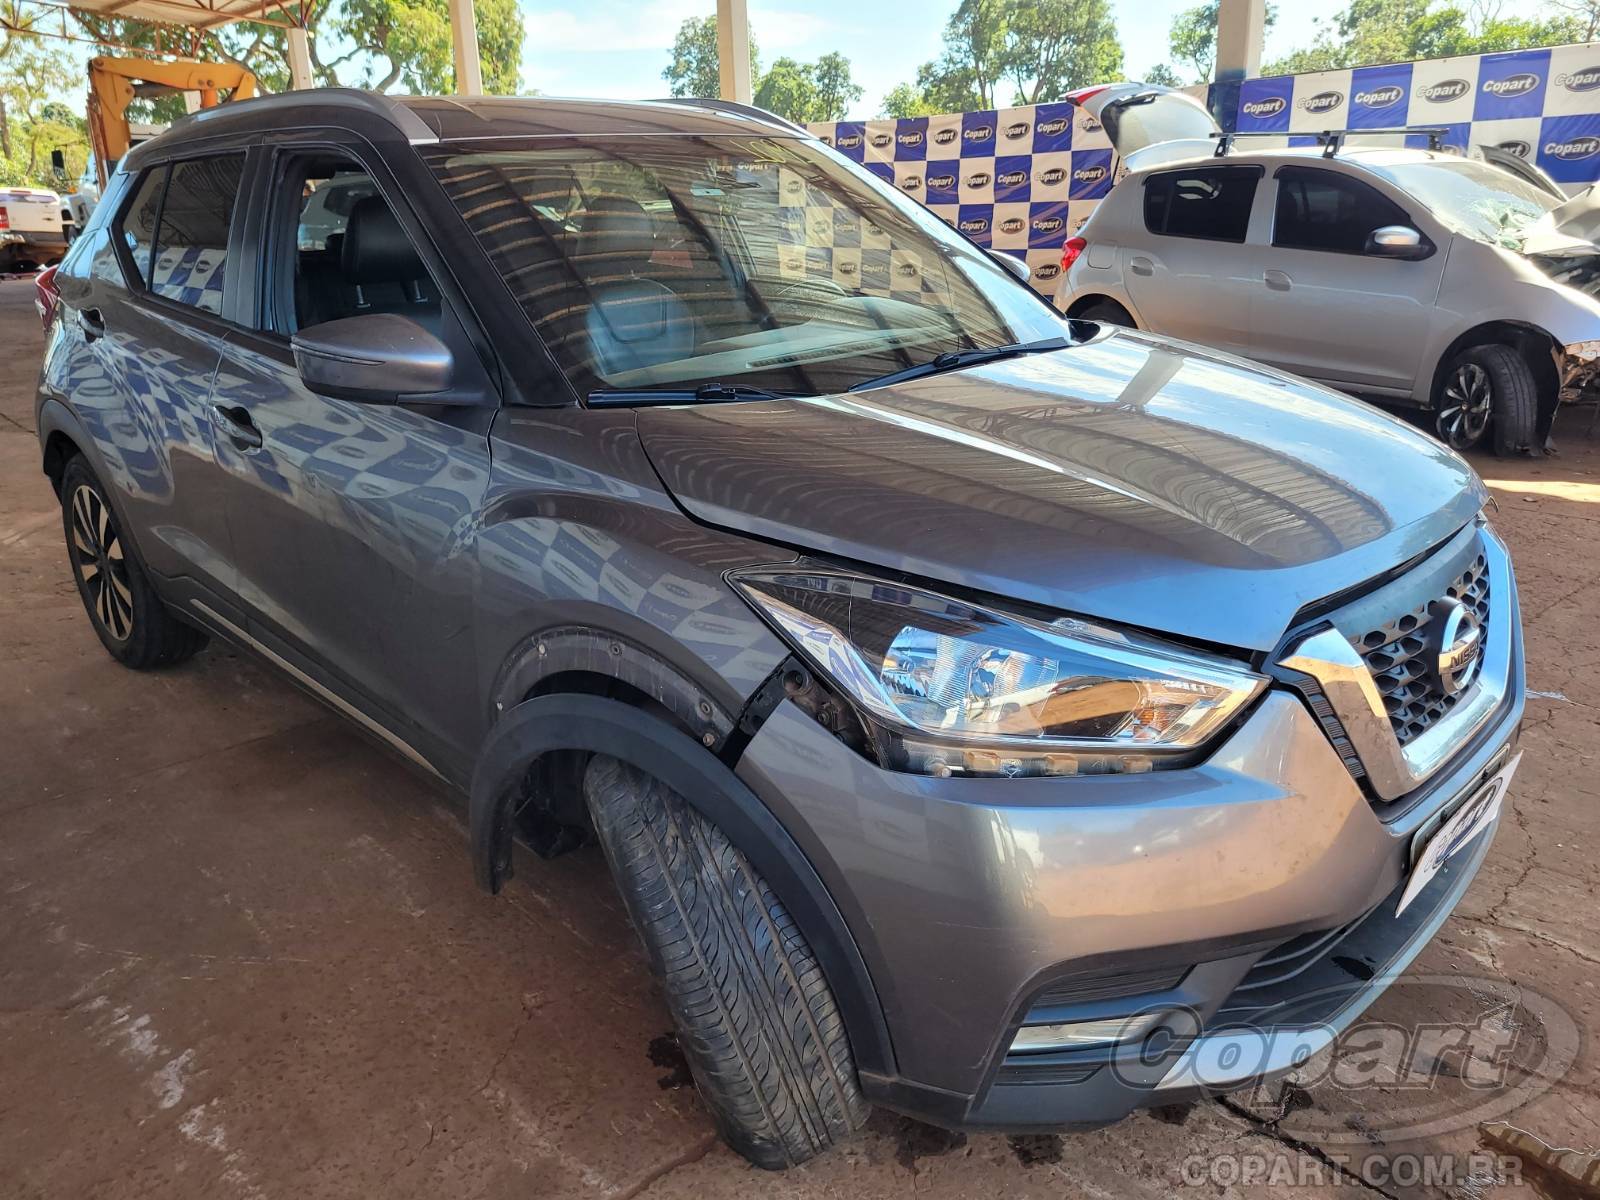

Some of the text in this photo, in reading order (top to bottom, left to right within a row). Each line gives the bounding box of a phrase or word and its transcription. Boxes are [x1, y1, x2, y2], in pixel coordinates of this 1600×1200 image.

[1482, 76, 1534, 94] Copart
[1555, 71, 1600, 88] Copar
[1354, 88, 1400, 105] Copart
[1416, 82, 1463, 99] Copart
[1243, 100, 1282, 115] Copart
[964, 127, 990, 140] Copart
[1037, 119, 1065, 134] Copart
[838, 137, 860, 148] Copart
[898, 132, 920, 146] Copart
[1544, 141, 1598, 160] Copart
[927, 176, 954, 188] Copart
[998, 173, 1024, 186] Copart
[1074, 168, 1103, 182] Copart
[960, 220, 986, 233] Copart
[1033, 217, 1060, 231] Copart
